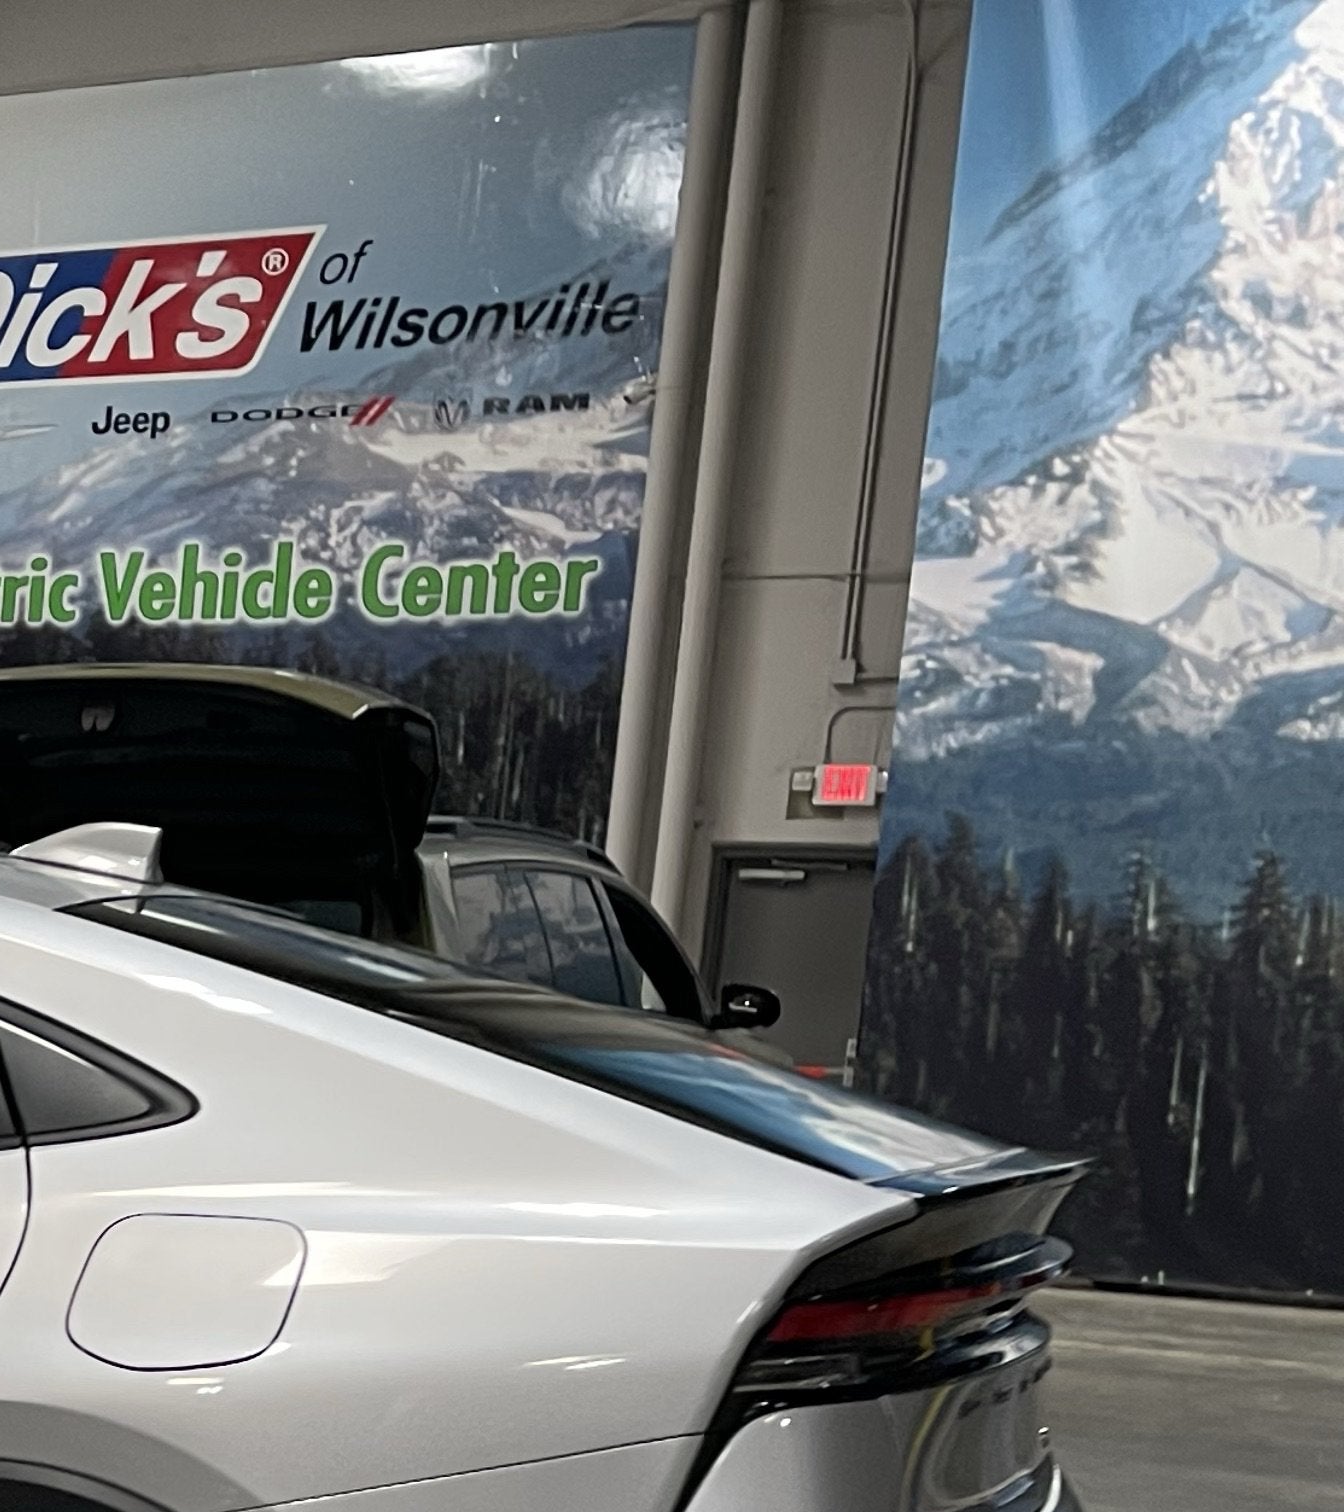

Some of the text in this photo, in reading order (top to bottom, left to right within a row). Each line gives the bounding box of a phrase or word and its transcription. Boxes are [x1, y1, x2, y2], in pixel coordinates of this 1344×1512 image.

[319, 240, 374, 285] of
[300, 280, 640, 353] Wilsonville
[91, 405, 171, 439] Jeep
[482, 392, 591, 415] RAM
[99, 542, 333, 621] Vehicle
[361, 545, 599, 618] Center
